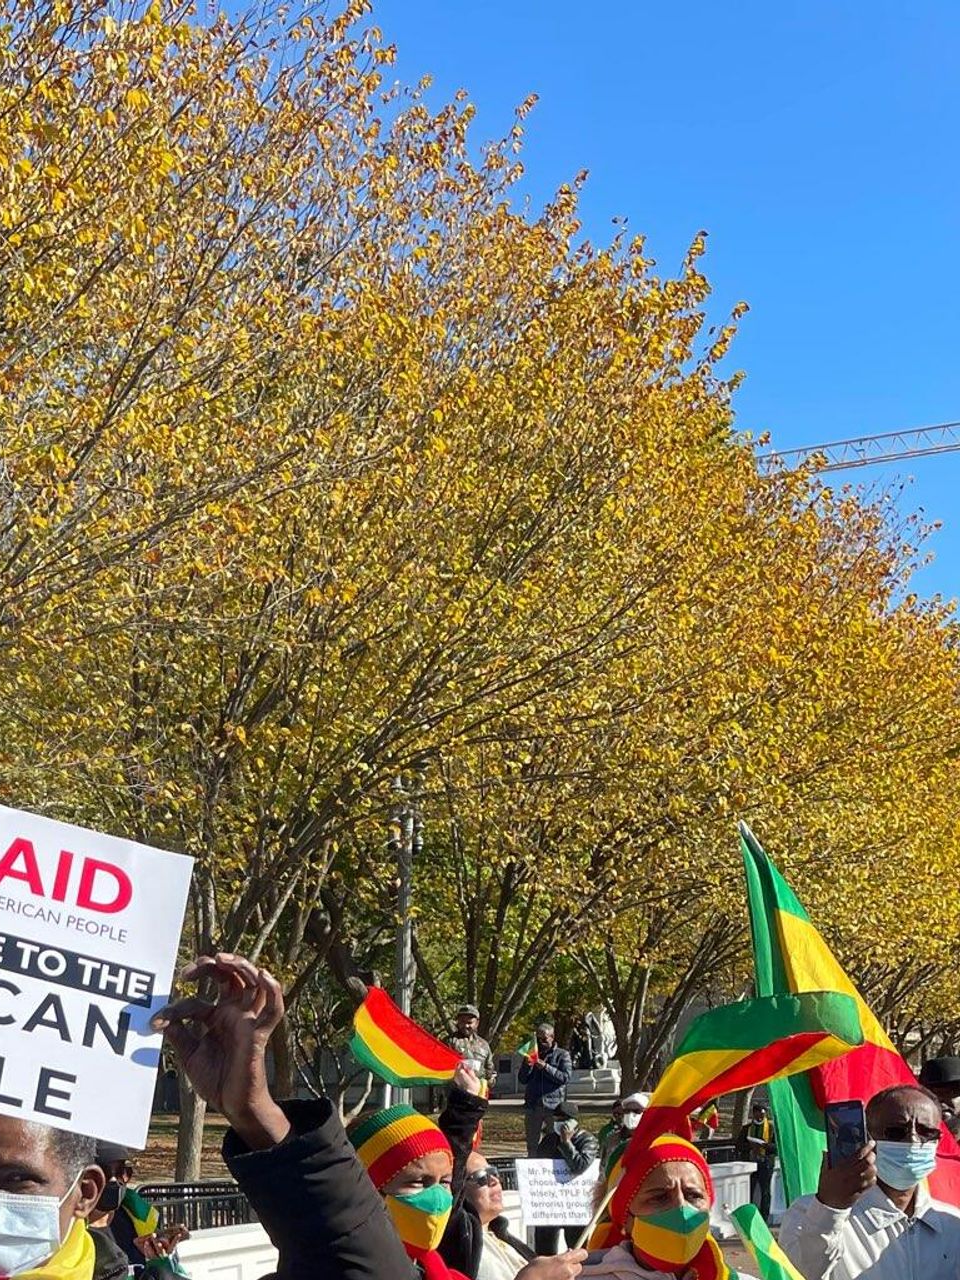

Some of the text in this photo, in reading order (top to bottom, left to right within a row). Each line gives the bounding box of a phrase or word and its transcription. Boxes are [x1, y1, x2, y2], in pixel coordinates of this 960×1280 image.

[66, 914, 129, 944] PEOPLE
[16, 941, 67, 977] TO
[77, 957, 152, 1000] THE
[527, 1167, 541, 1175] Mr.
[530, 1200, 564, 1208] terrorist
[532, 1211, 567, 1219] different
[569, 1211, 588, 1219] than
